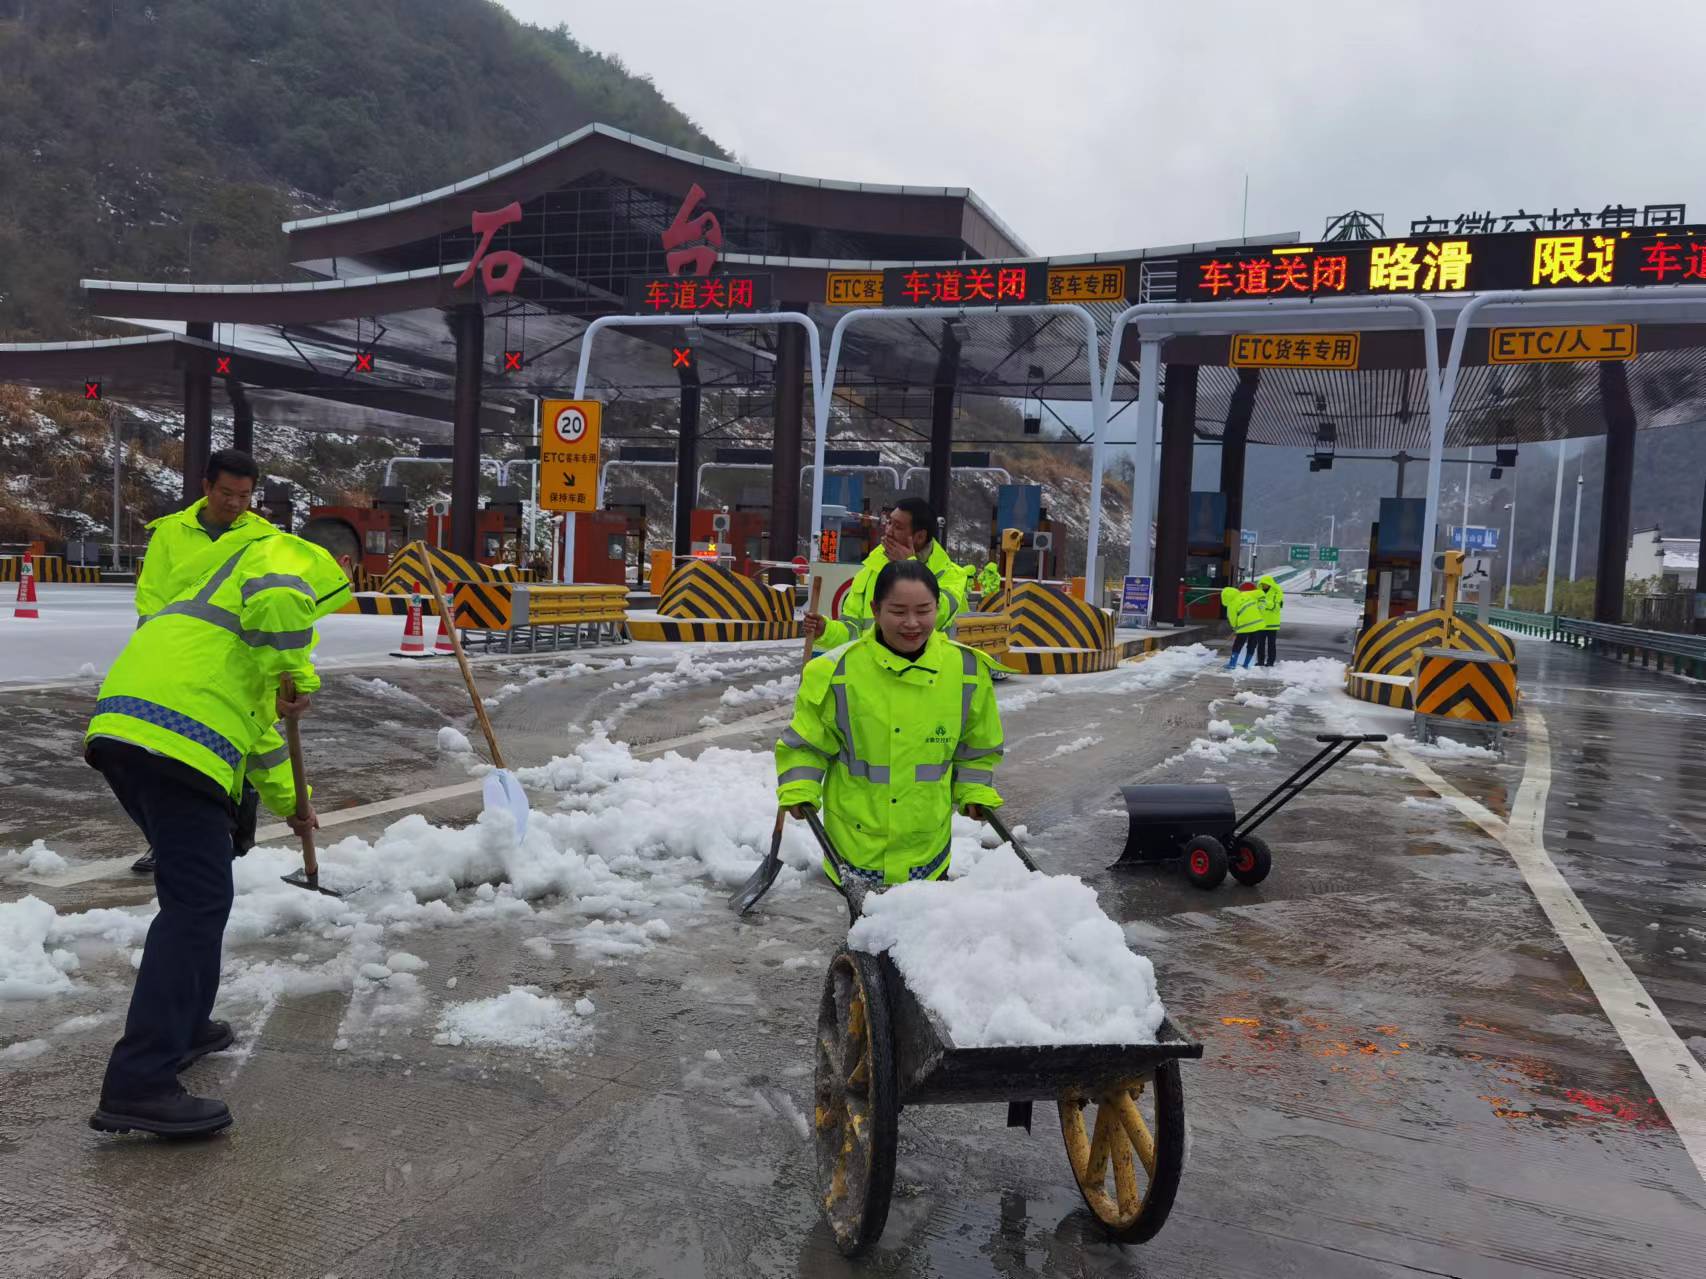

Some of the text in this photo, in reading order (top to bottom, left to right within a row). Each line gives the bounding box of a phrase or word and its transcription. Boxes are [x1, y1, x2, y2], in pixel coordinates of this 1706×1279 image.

[453, 182, 722, 295] 石 台
[1198, 255, 1348, 296] 车道关闭
[1368, 240, 1473, 291] 路滑
[645, 279, 753, 310] 车道关闭
[832, 279, 885, 299] ETC客
[902, 267, 1027, 303] 车道关闭
[1049, 273, 1118, 296] 客车专用
[1238, 338, 1352, 361] ETC货车专用
[561, 416, 582, 434] 20
[550, 492, 586, 504] 保持车距
